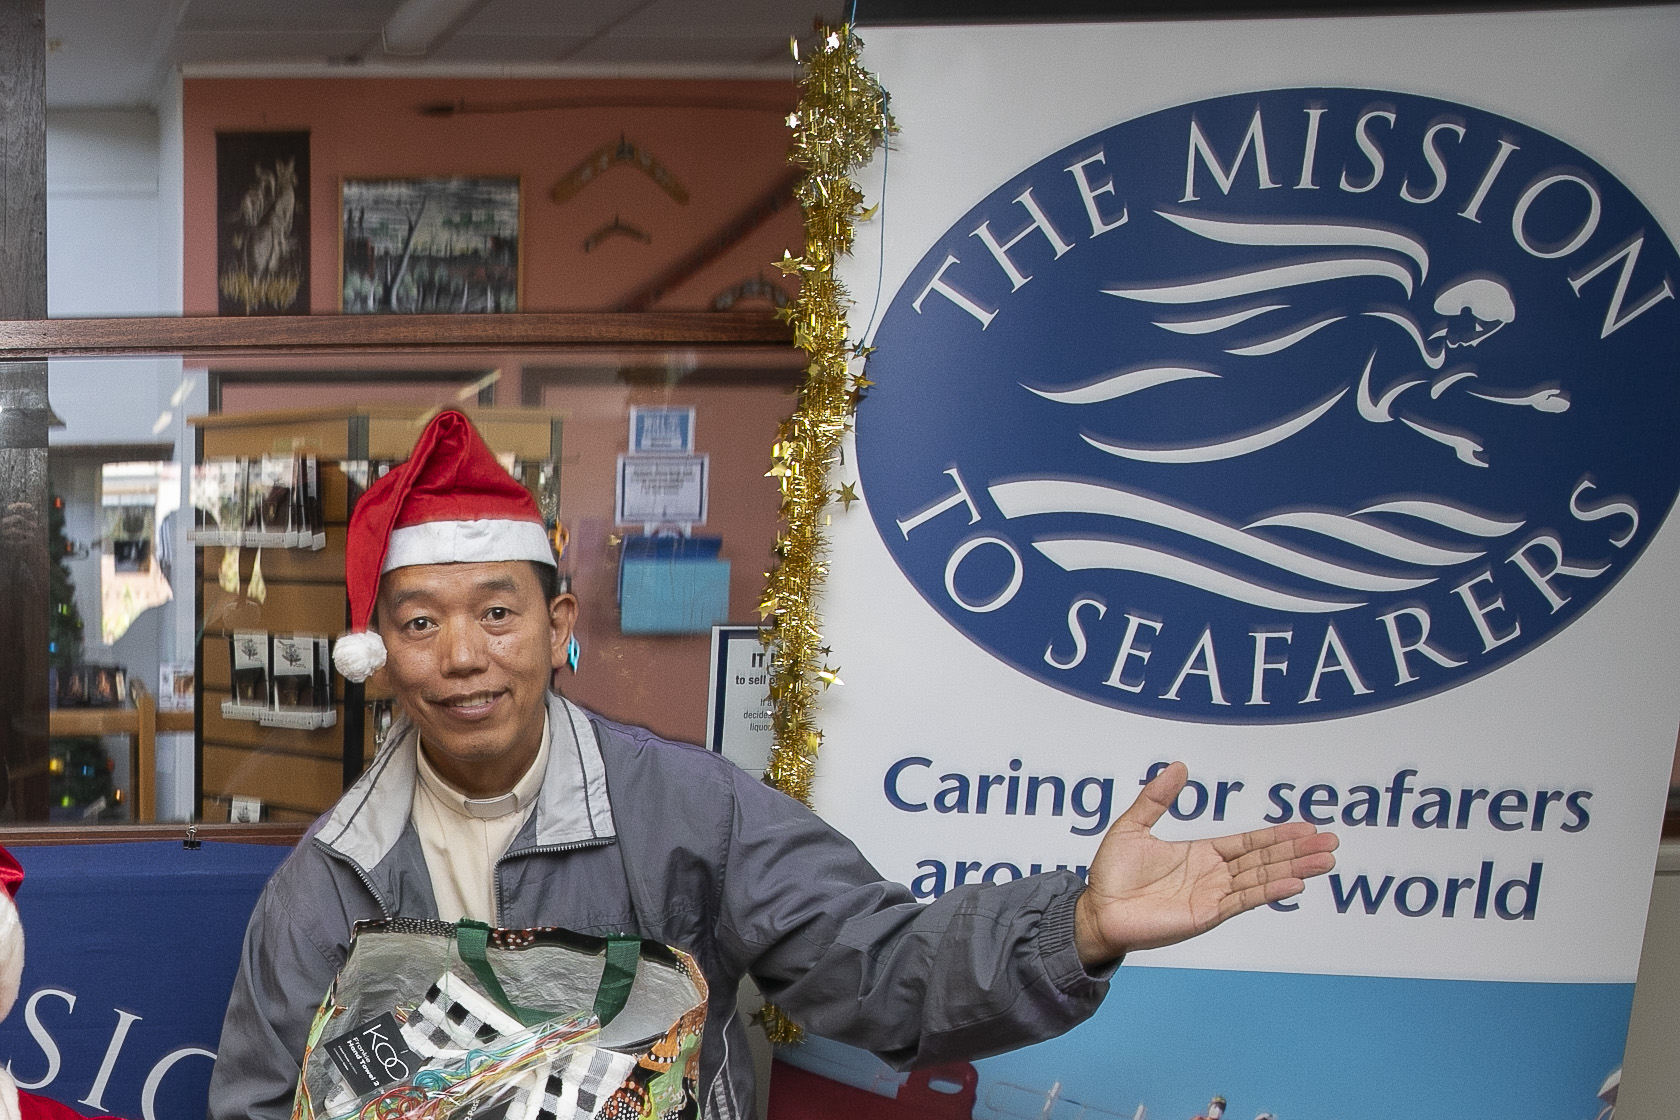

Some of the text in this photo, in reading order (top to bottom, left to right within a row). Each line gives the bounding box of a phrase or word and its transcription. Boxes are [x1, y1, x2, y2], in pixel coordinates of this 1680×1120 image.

[912, 107, 1675, 341] THE MISSION
[895, 468, 1640, 707] TO SEAFARERS
[882, 757, 1593, 836] Caring or seafarers
[1328, 861, 1545, 922] world
[346, 1040, 376, 1081] Hand Towel
[352, 1037, 371, 1064] Frankie
[363, 1024, 410, 1081] KOO
